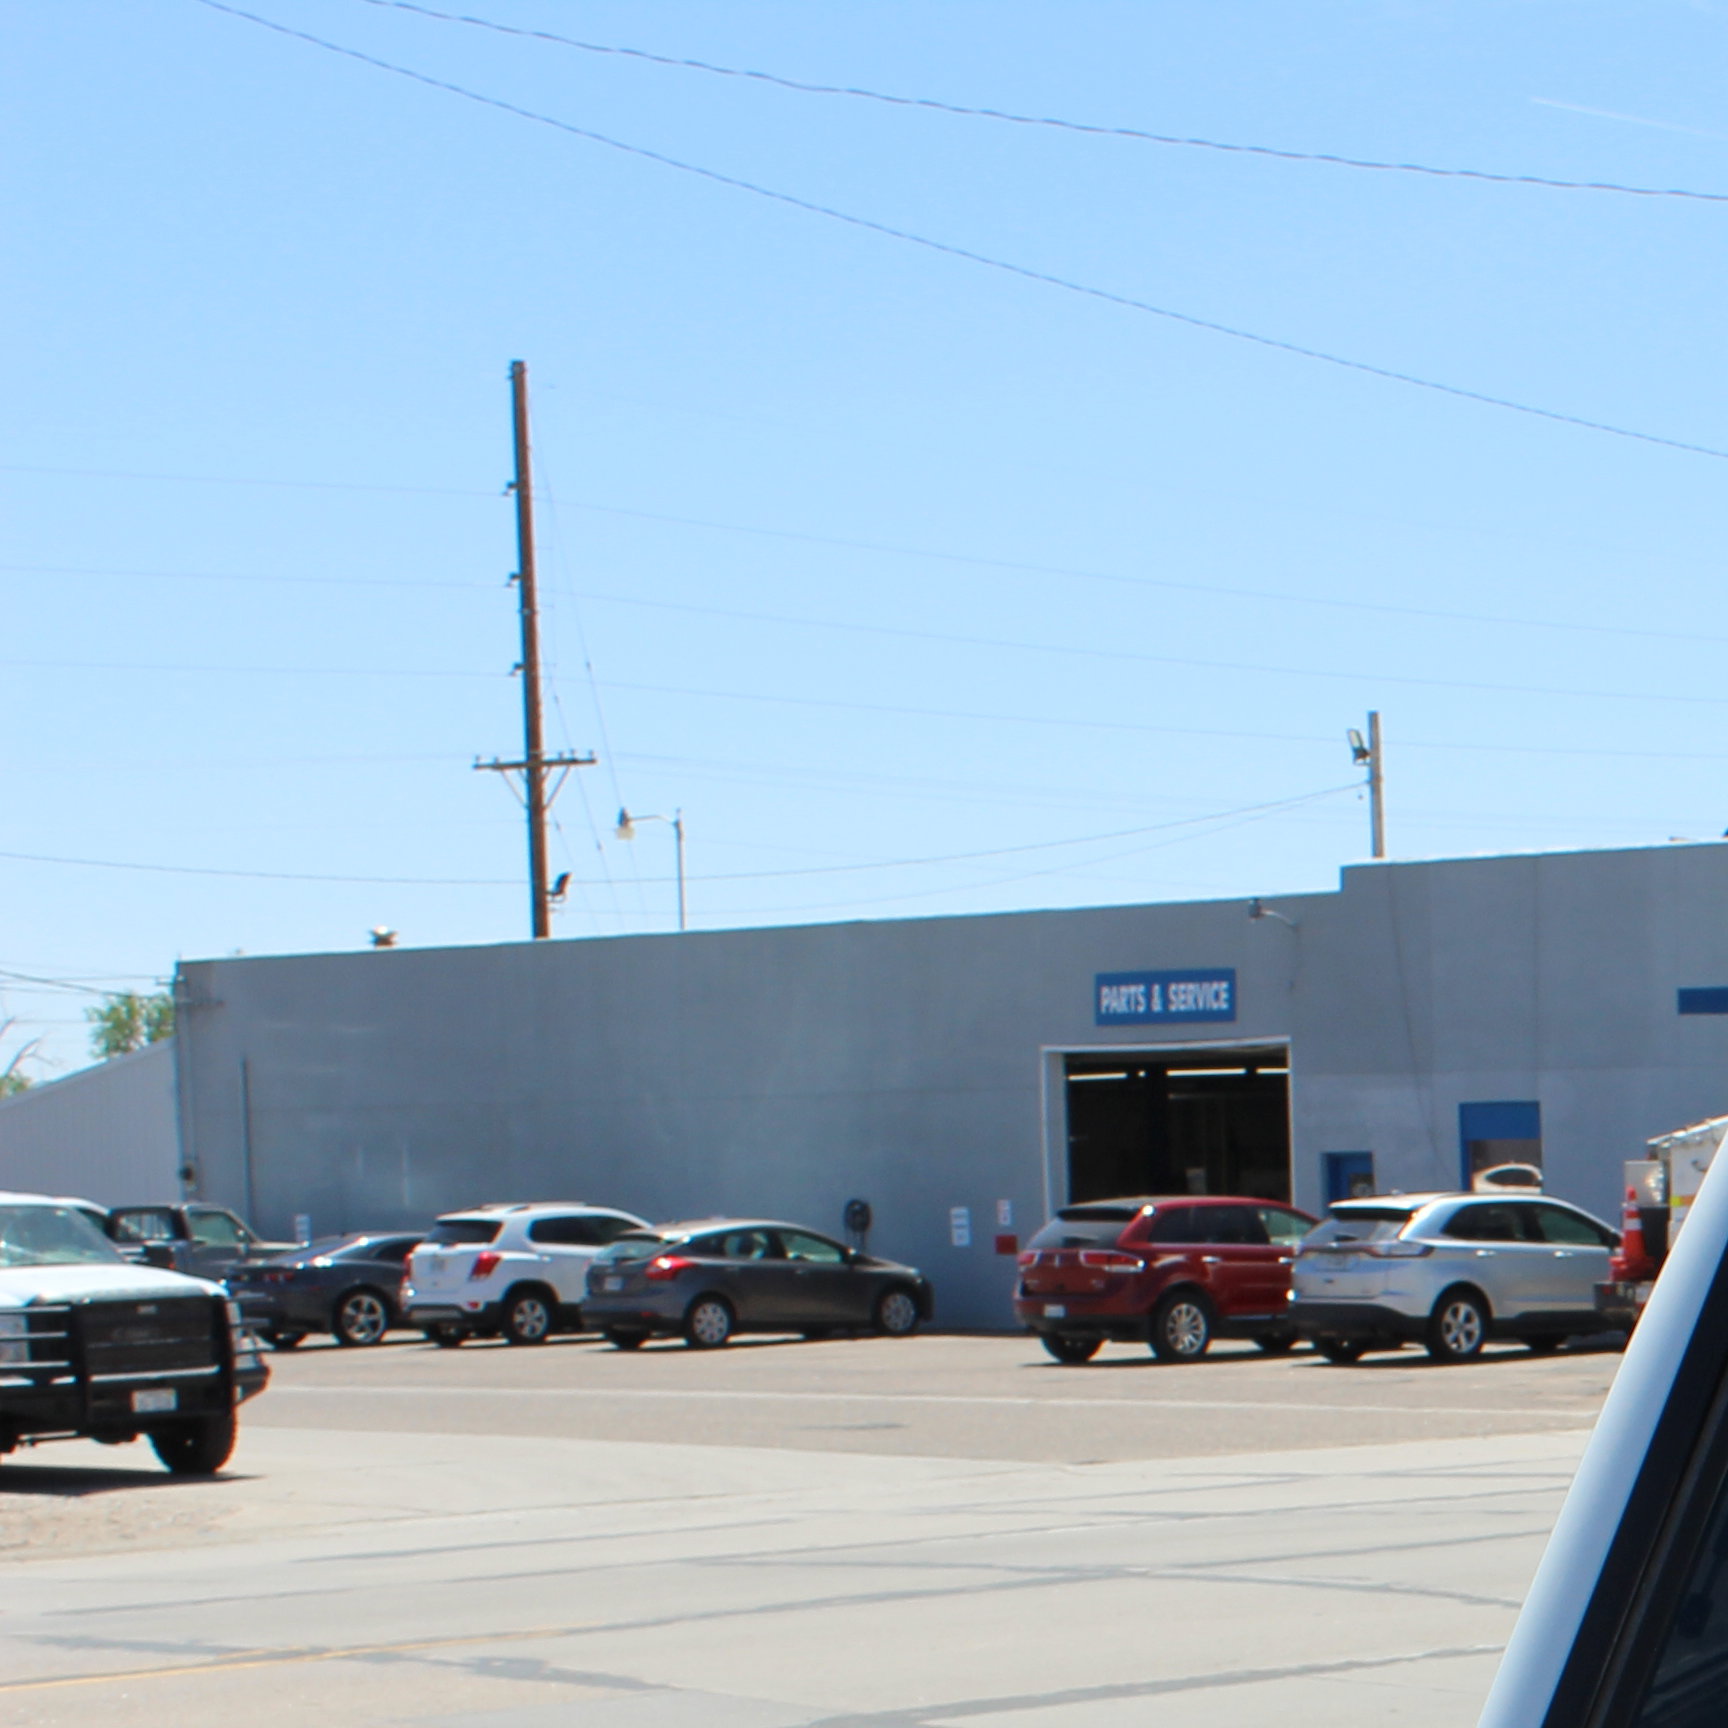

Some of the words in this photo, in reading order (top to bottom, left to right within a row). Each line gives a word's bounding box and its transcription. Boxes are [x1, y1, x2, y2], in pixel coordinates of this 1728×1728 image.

[1101, 984, 1146, 1014] PARTS
[1152, 984, 1163, 1013] &
[1168, 981, 1230, 1011] SERVICE
